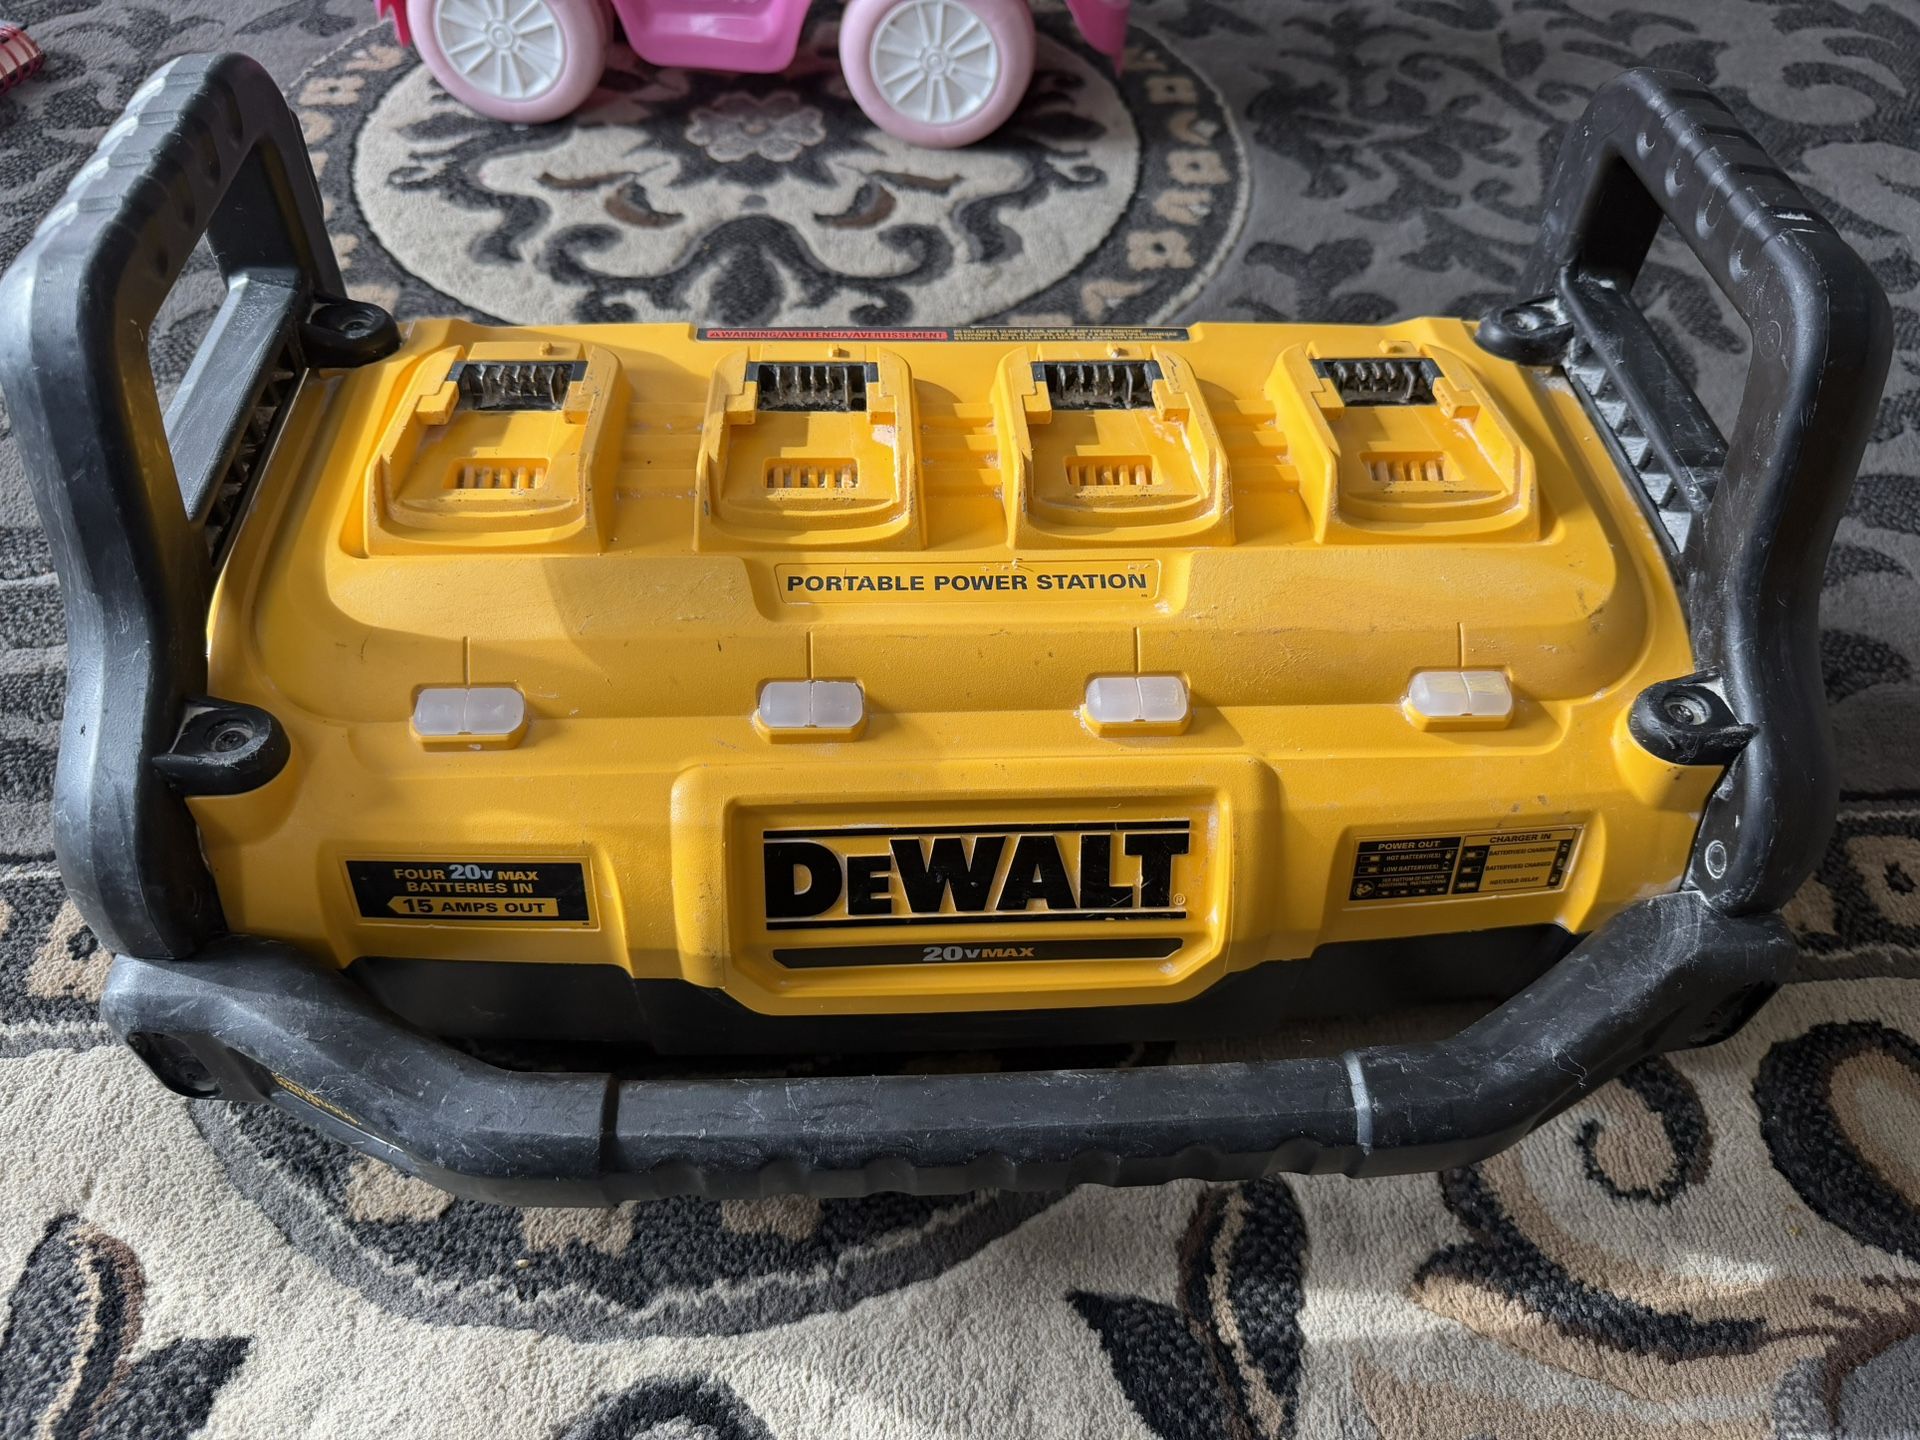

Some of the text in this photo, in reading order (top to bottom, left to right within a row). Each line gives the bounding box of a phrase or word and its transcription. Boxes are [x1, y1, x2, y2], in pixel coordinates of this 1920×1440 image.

[787, 573, 1147, 592] PORTABLE POWER STATION
[1378, 840, 1441, 850] POWER OUT
[1489, 834, 1538, 843] CHARGER
[394, 869, 445, 880] FOUR
[497, 871, 539, 881] MAX
[763, 832, 1190, 919] DEWALT
[406, 881, 534, 894] BATTERIES IN
[403, 899, 546, 913] 15 AMPS OUT
